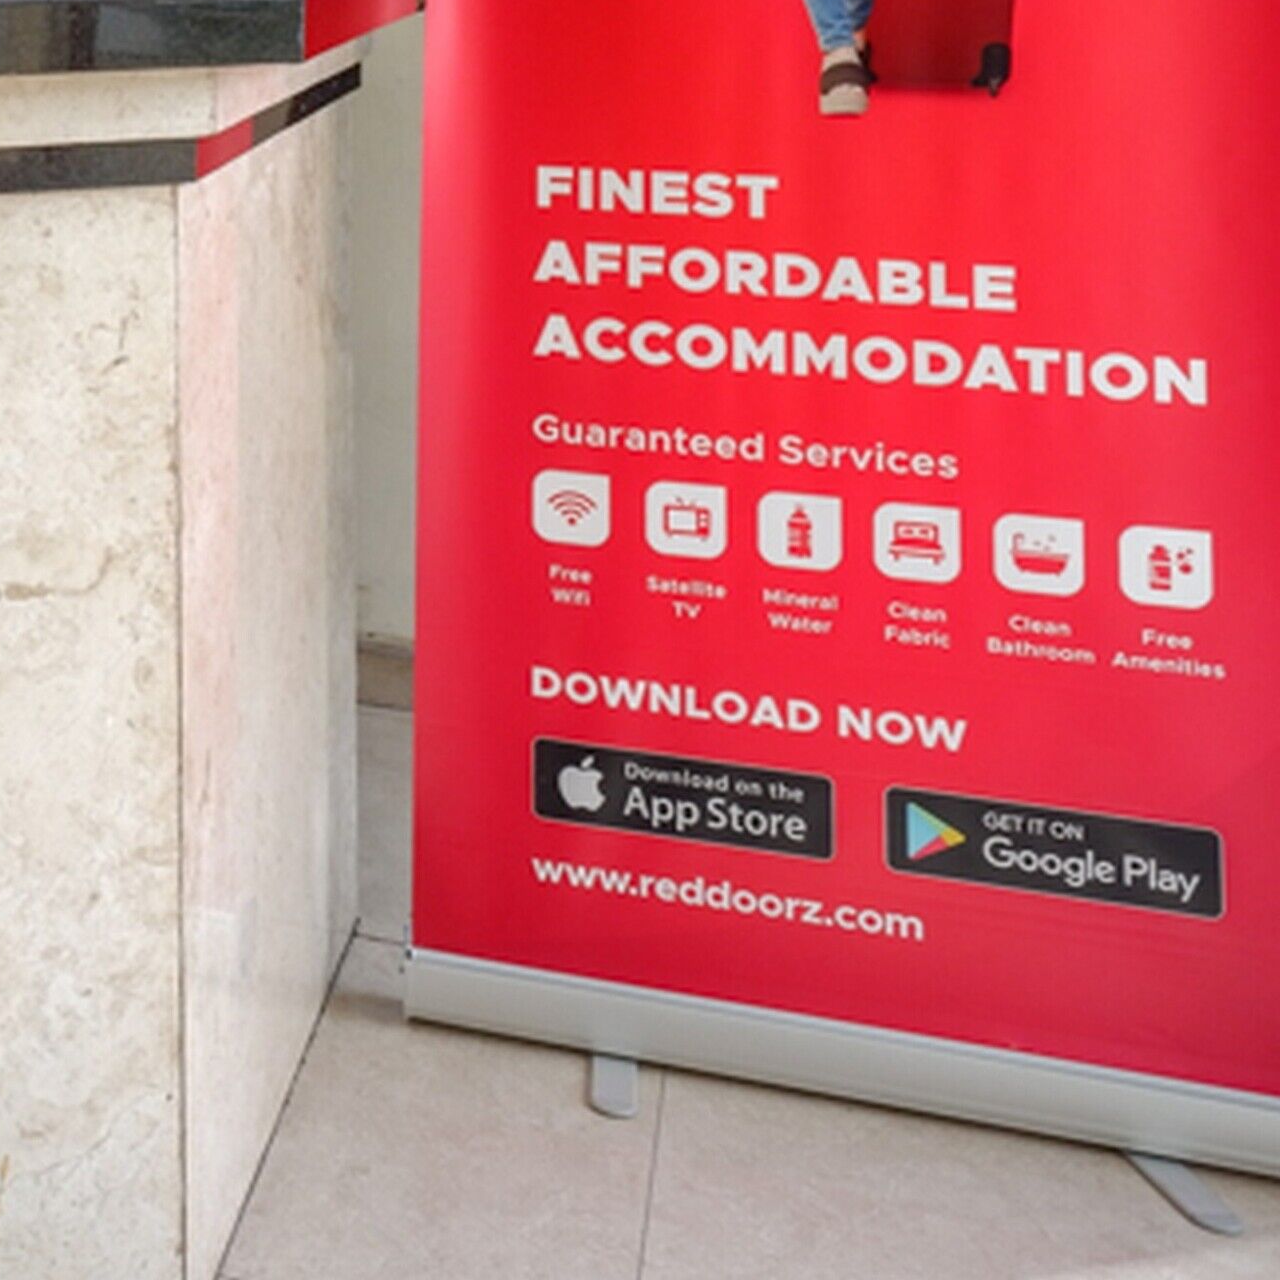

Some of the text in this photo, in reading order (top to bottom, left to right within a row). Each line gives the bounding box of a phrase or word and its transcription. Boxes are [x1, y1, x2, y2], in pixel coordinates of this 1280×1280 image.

[536, 165, 779, 219] FINEST
[534, 240, 1017, 312] AFFORDABLE
[534, 314, 1209, 406] ACCOMMODATION
[532, 413, 959, 479] Guaranteed Services
[549, 564, 592, 584] Free
[646, 576, 728, 599] Satellite
[673, 600, 701, 619] TV
[762, 588, 839, 611] Mineral
[888, 601, 947, 624] Clean
[767, 612, 833, 635] Water
[884, 625, 951, 650] Fabric
[1008, 614, 1072, 637] Clean
[987, 636, 1096, 665] Bathroom
[1142, 628, 1193, 651] Free
[1112, 651, 1227, 681] Amenities
[531, 666, 968, 753] DOWNLOAD NOW
[624, 761, 805, 803] Download on the
[623, 786, 808, 841] App Store
[983, 812, 1085, 841] GET IT ON
[983, 836, 1201, 903] Google Play
[532, 858, 925, 941] www.reddoorz.com
